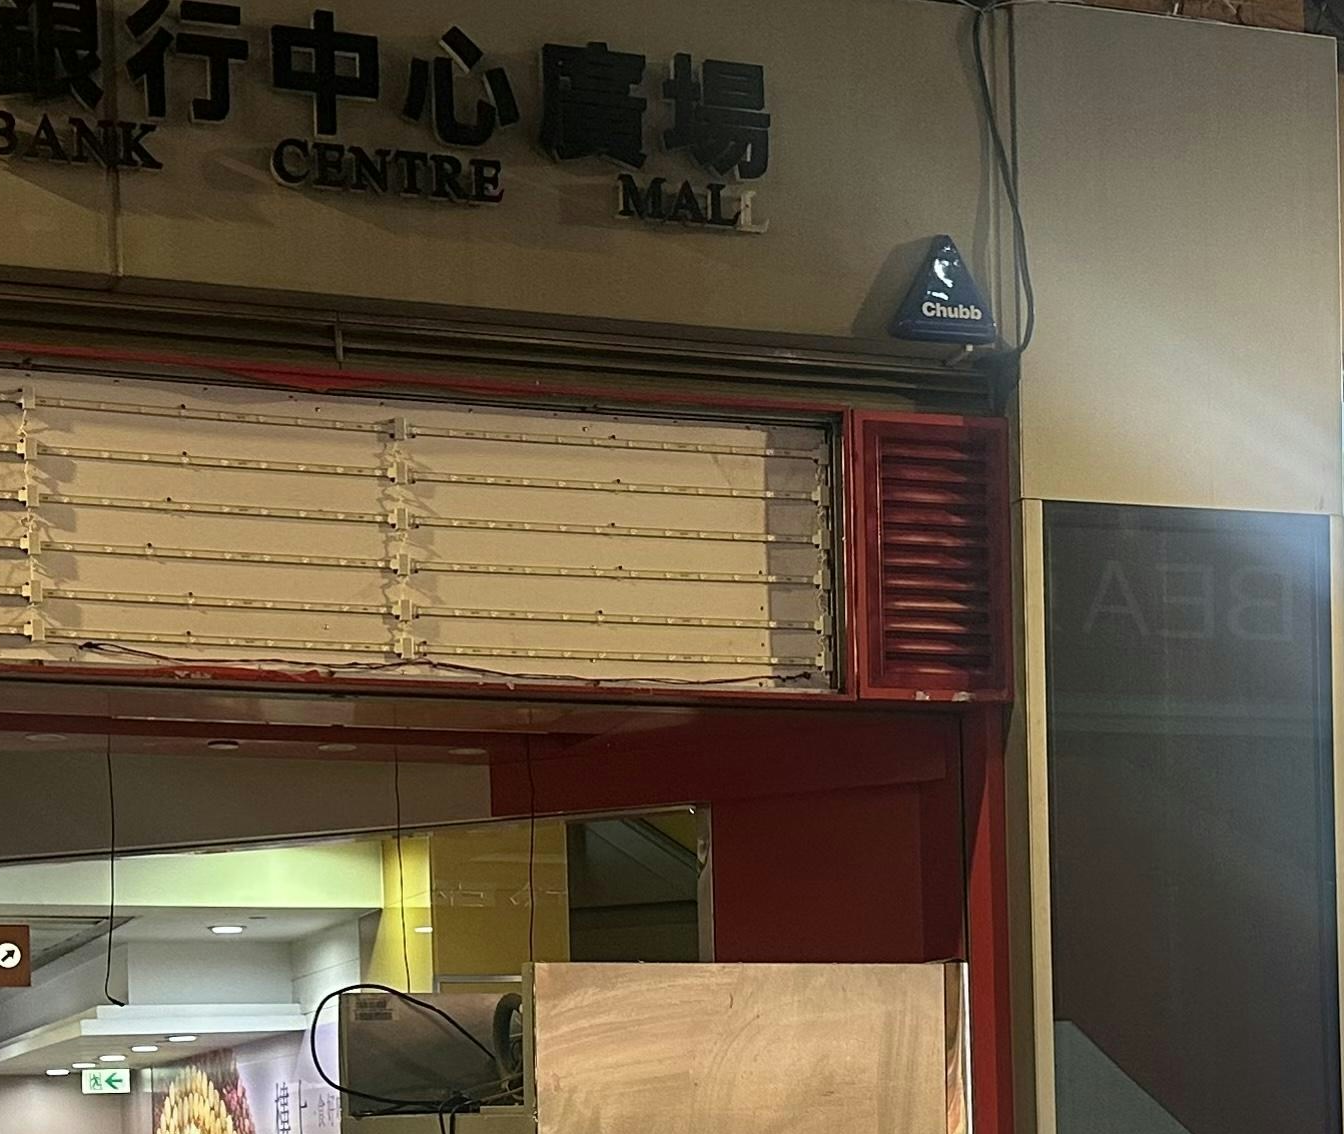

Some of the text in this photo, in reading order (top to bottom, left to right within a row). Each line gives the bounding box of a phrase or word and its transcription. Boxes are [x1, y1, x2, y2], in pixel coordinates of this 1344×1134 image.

[270, 137, 505, 205] CENTRE
[615, 172, 771, 234] MALL
[921, 301, 983, 320] Chubb
